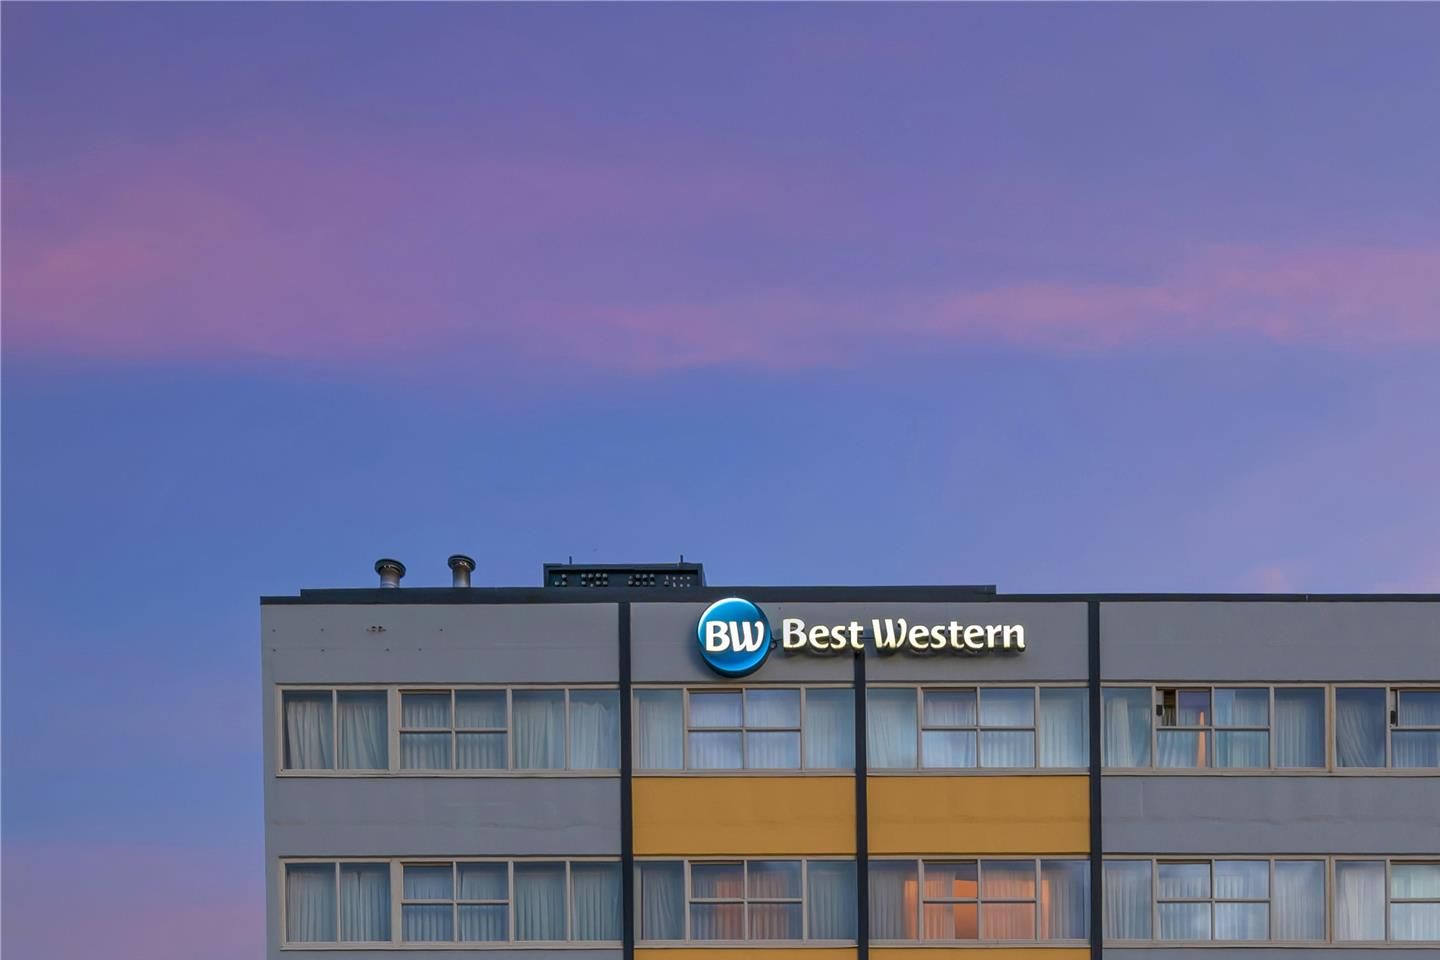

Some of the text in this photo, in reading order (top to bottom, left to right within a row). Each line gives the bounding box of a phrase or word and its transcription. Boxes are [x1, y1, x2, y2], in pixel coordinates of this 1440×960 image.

[705, 621, 765, 652] BW
[782, 618, 1026, 650] Best Western
